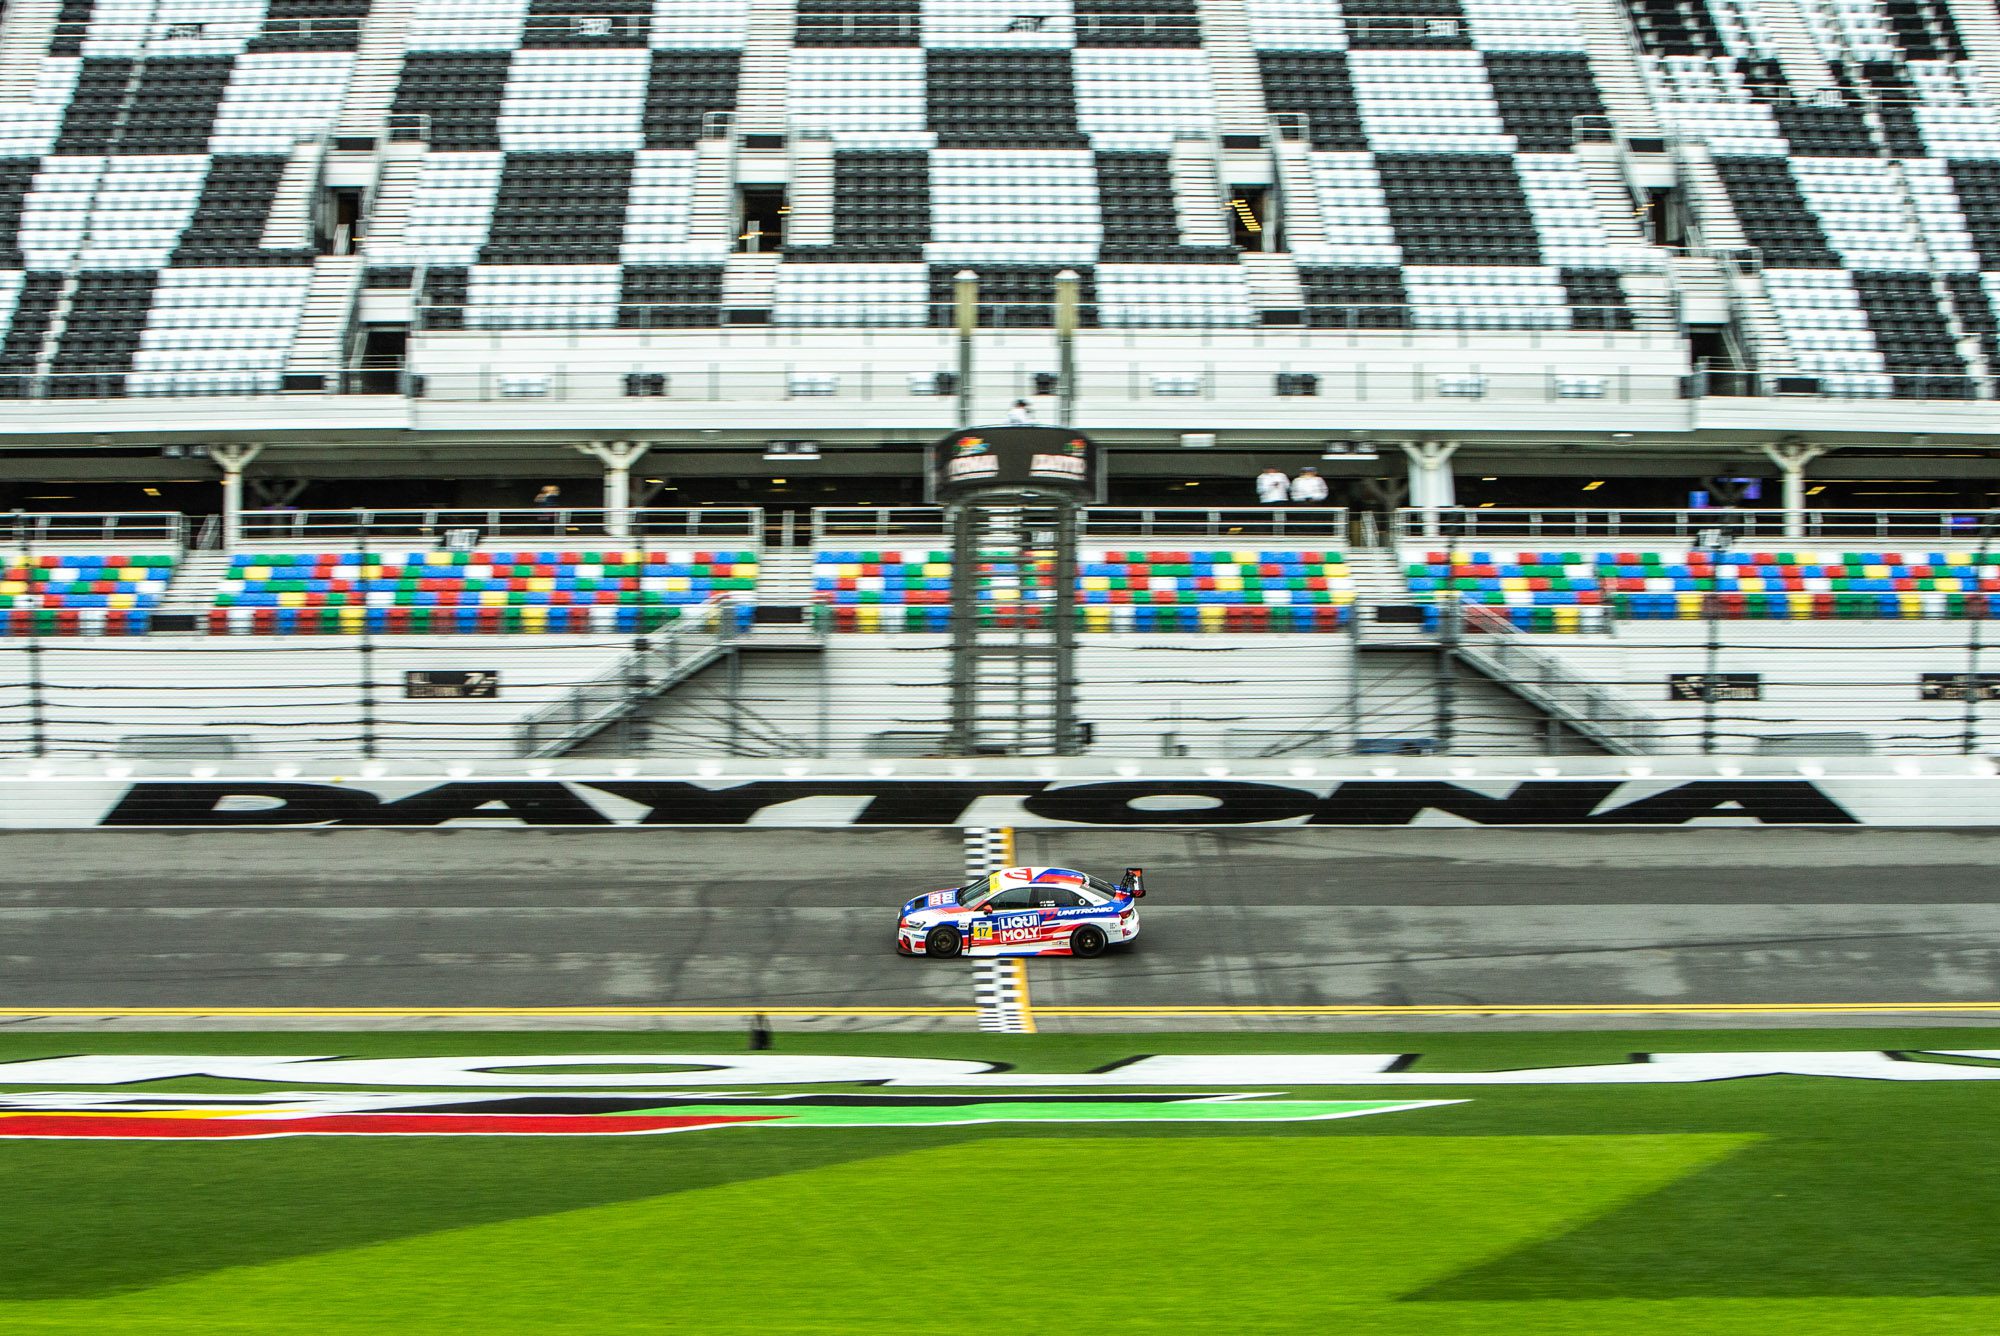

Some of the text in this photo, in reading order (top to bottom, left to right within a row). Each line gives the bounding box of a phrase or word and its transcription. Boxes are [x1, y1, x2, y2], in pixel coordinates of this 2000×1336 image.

[100, 782, 1862, 825] DAYTONA
[1057, 906, 1114, 916] UNITRONIC
[1000, 915, 1037, 929] LIQUI
[977, 927, 988, 937] 17
[1001, 927, 1039, 941] MOLY
